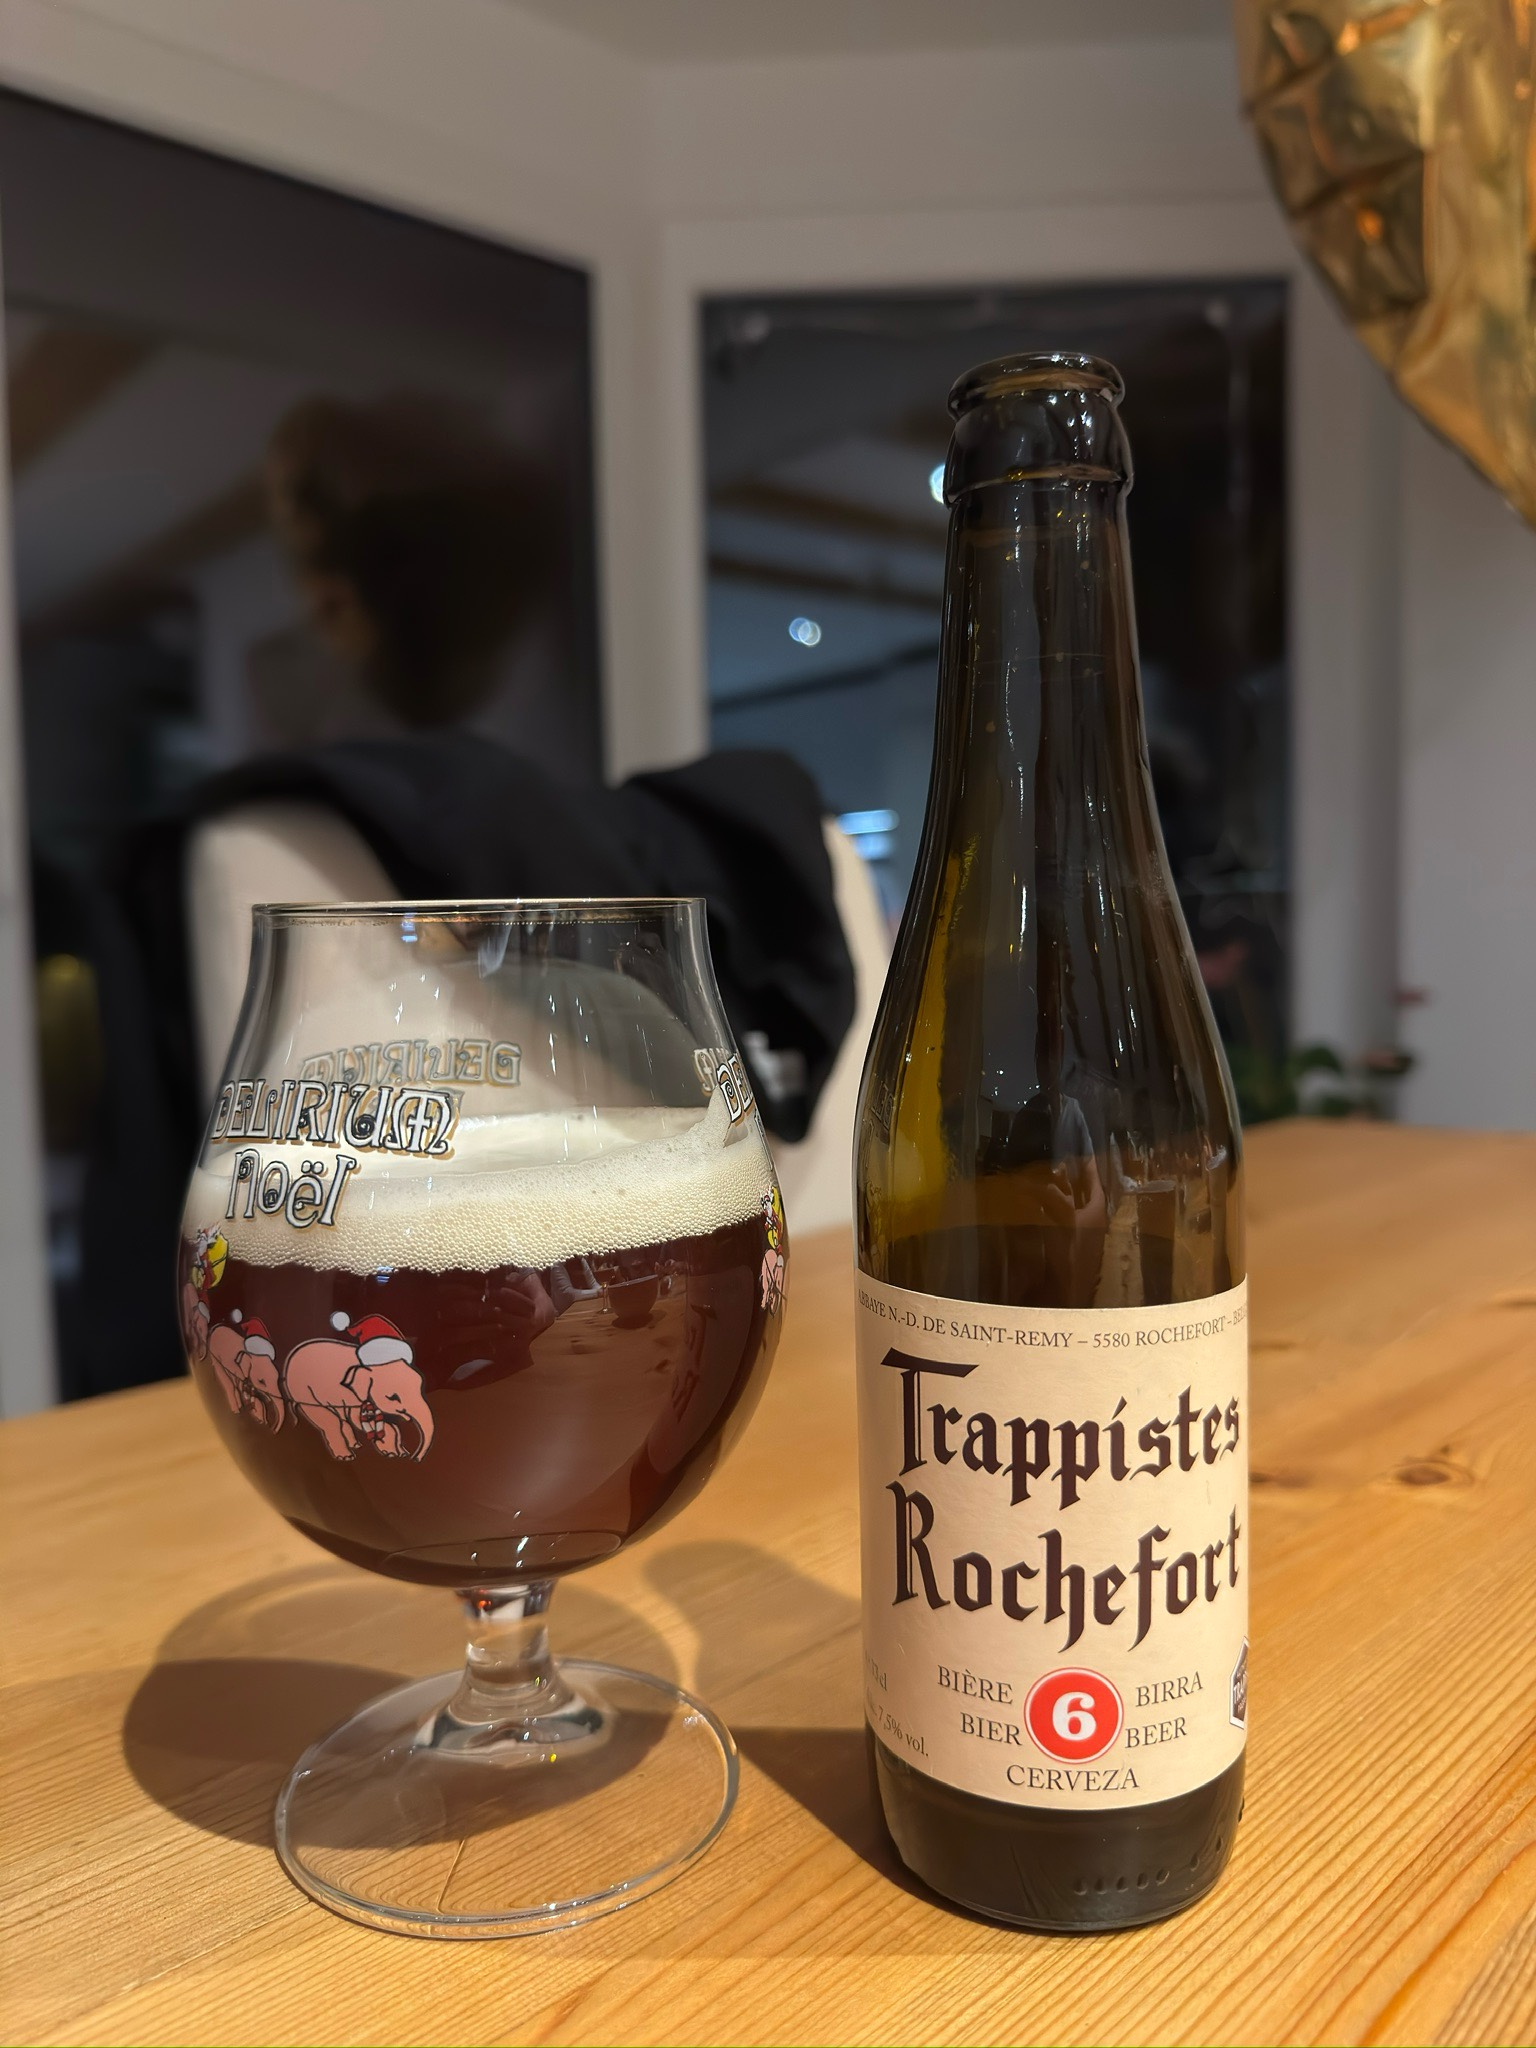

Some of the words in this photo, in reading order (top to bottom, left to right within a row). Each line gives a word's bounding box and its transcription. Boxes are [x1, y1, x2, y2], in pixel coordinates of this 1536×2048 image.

[210, 1078, 455, 1156] DELIRIUM
[922, 1315, 946, 1336] DE
[950, 1320, 1073, 1348] SAINT-REMY
[1092, 1332, 1131, 1349] 5580
[1134, 1315, 1226, 1347] ROCHEFORT
[884, 1480, 1242, 1654] Rochefort
[936, 1664, 1014, 1706] BIÈRE
[1134, 1670, 1204, 1708] BIRRA
[959, 1711, 1023, 1747] BIER
[1051, 1690, 1098, 1742] 6
[1124, 1716, 1188, 1749] BEER
[905, 1733, 929, 1757] vol.
[1005, 1763, 1141, 1792] CERVEZA
